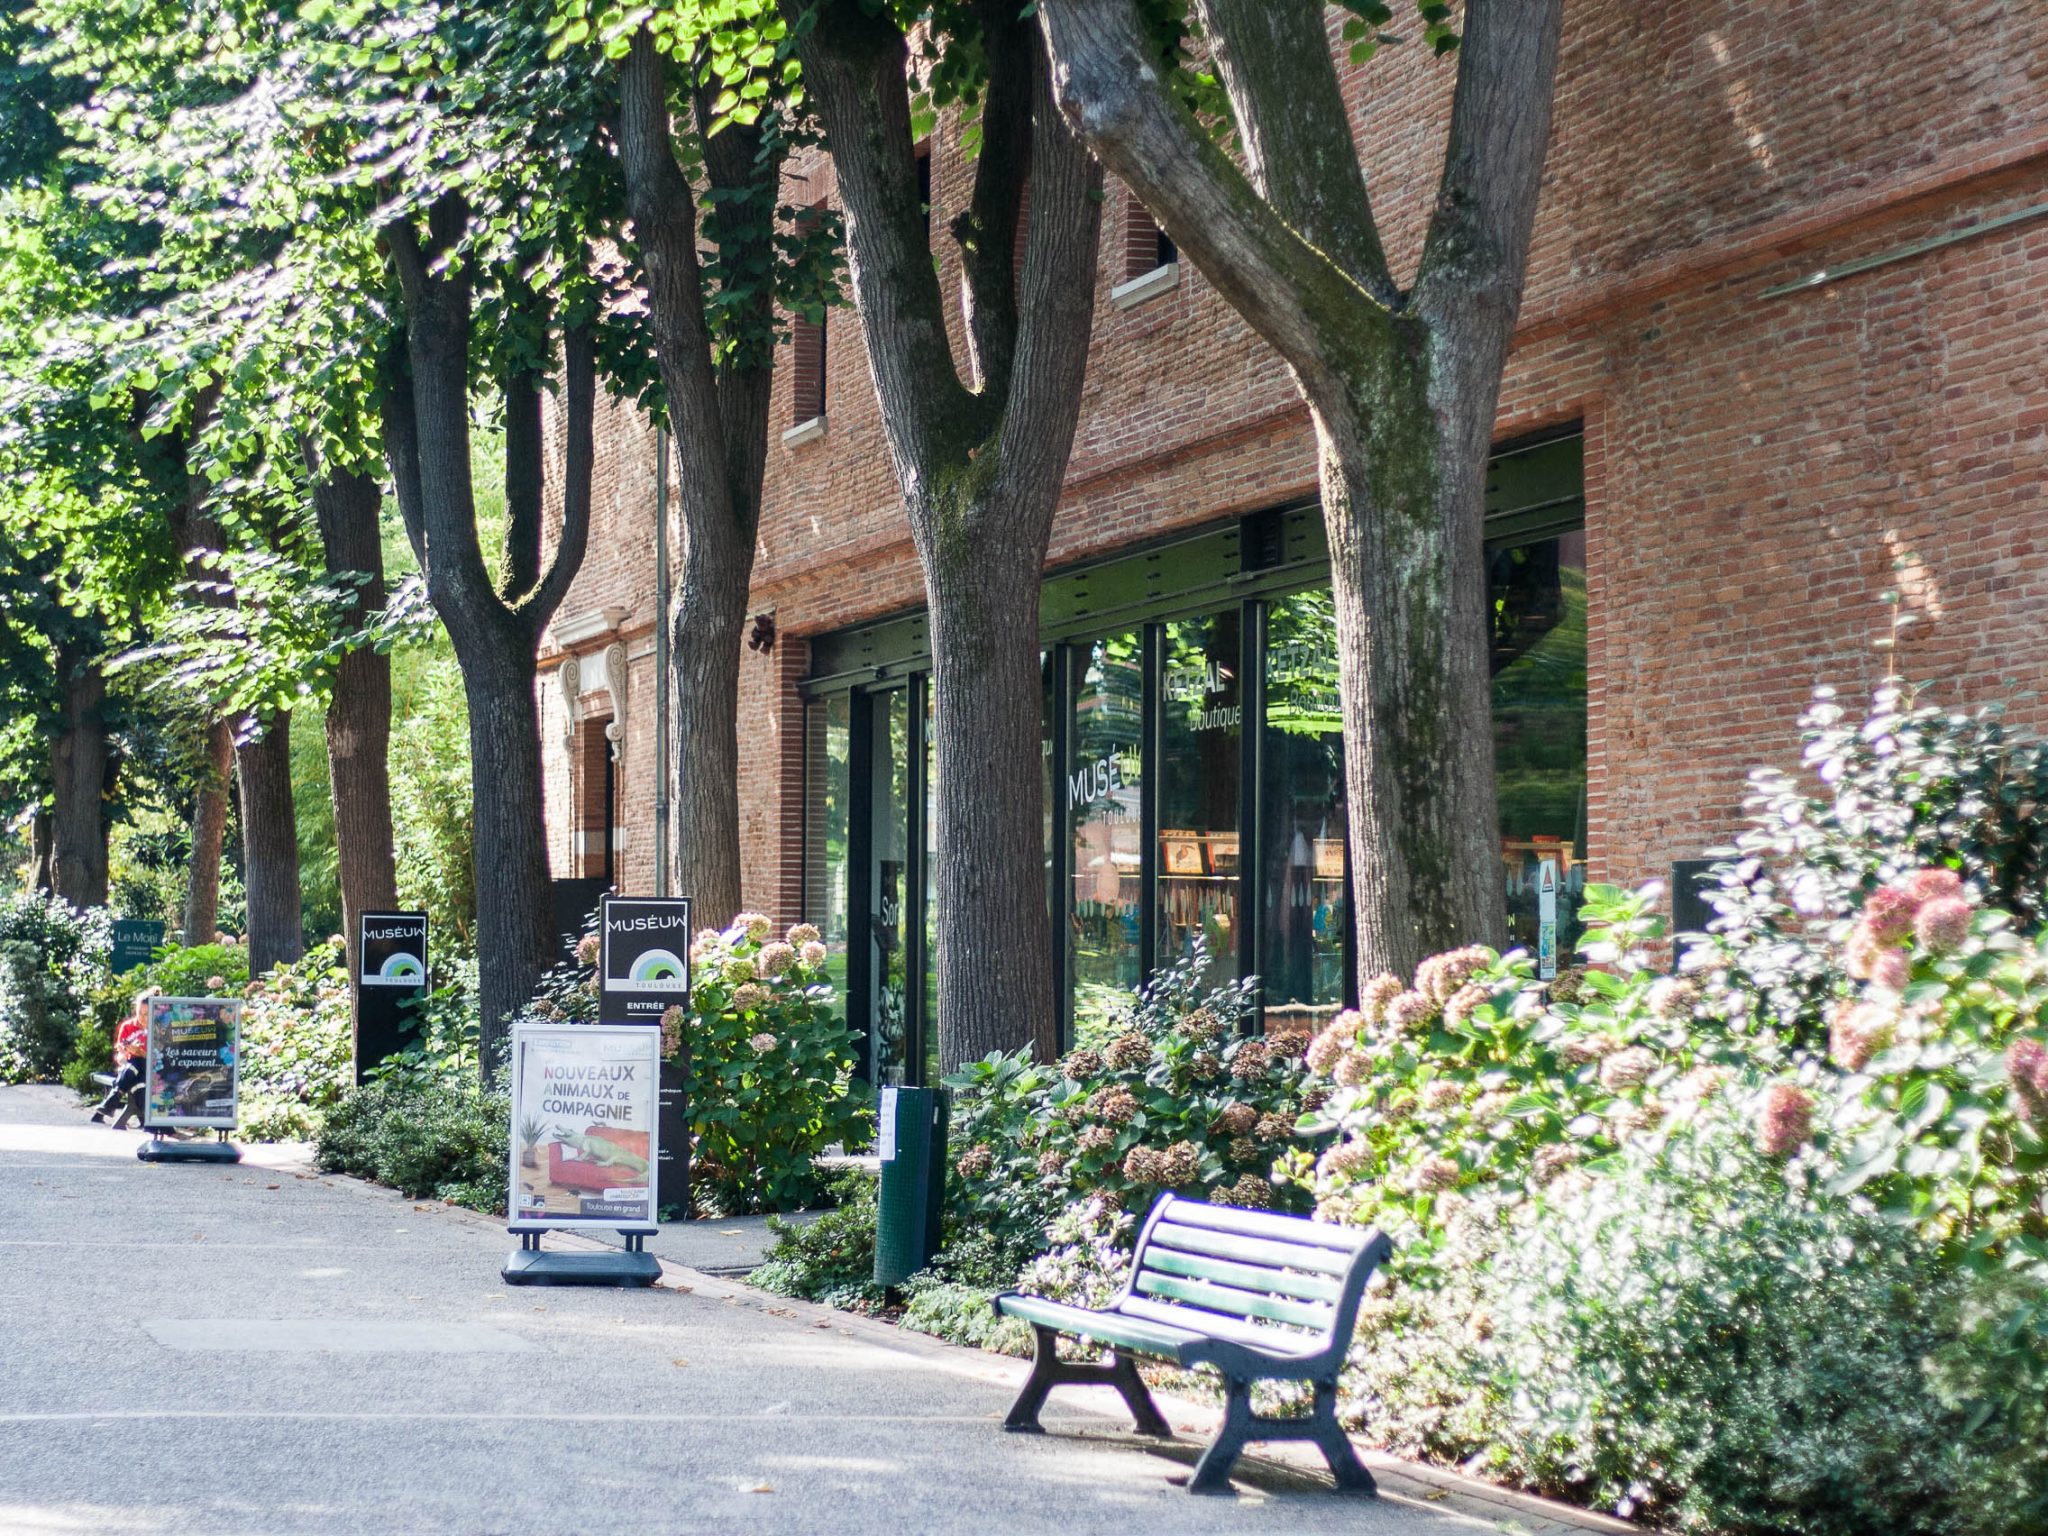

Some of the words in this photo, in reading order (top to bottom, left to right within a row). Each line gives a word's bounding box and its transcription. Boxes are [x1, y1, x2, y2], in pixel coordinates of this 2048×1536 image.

[118, 931, 131, 943] Le
[627, 1000, 665, 1010] ENTRÉE
[166, 1047, 179, 1058] Les
[181, 1047, 217, 1057] saveurs
[544, 1065, 635, 1081] NOUVEAUX
[543, 1083, 613, 1099] ANIMAUX
[617, 1091, 630, 1100] DE
[542, 1099, 633, 1121] COMPAGNIE
[586, 1202, 613, 1212] Toulouse
